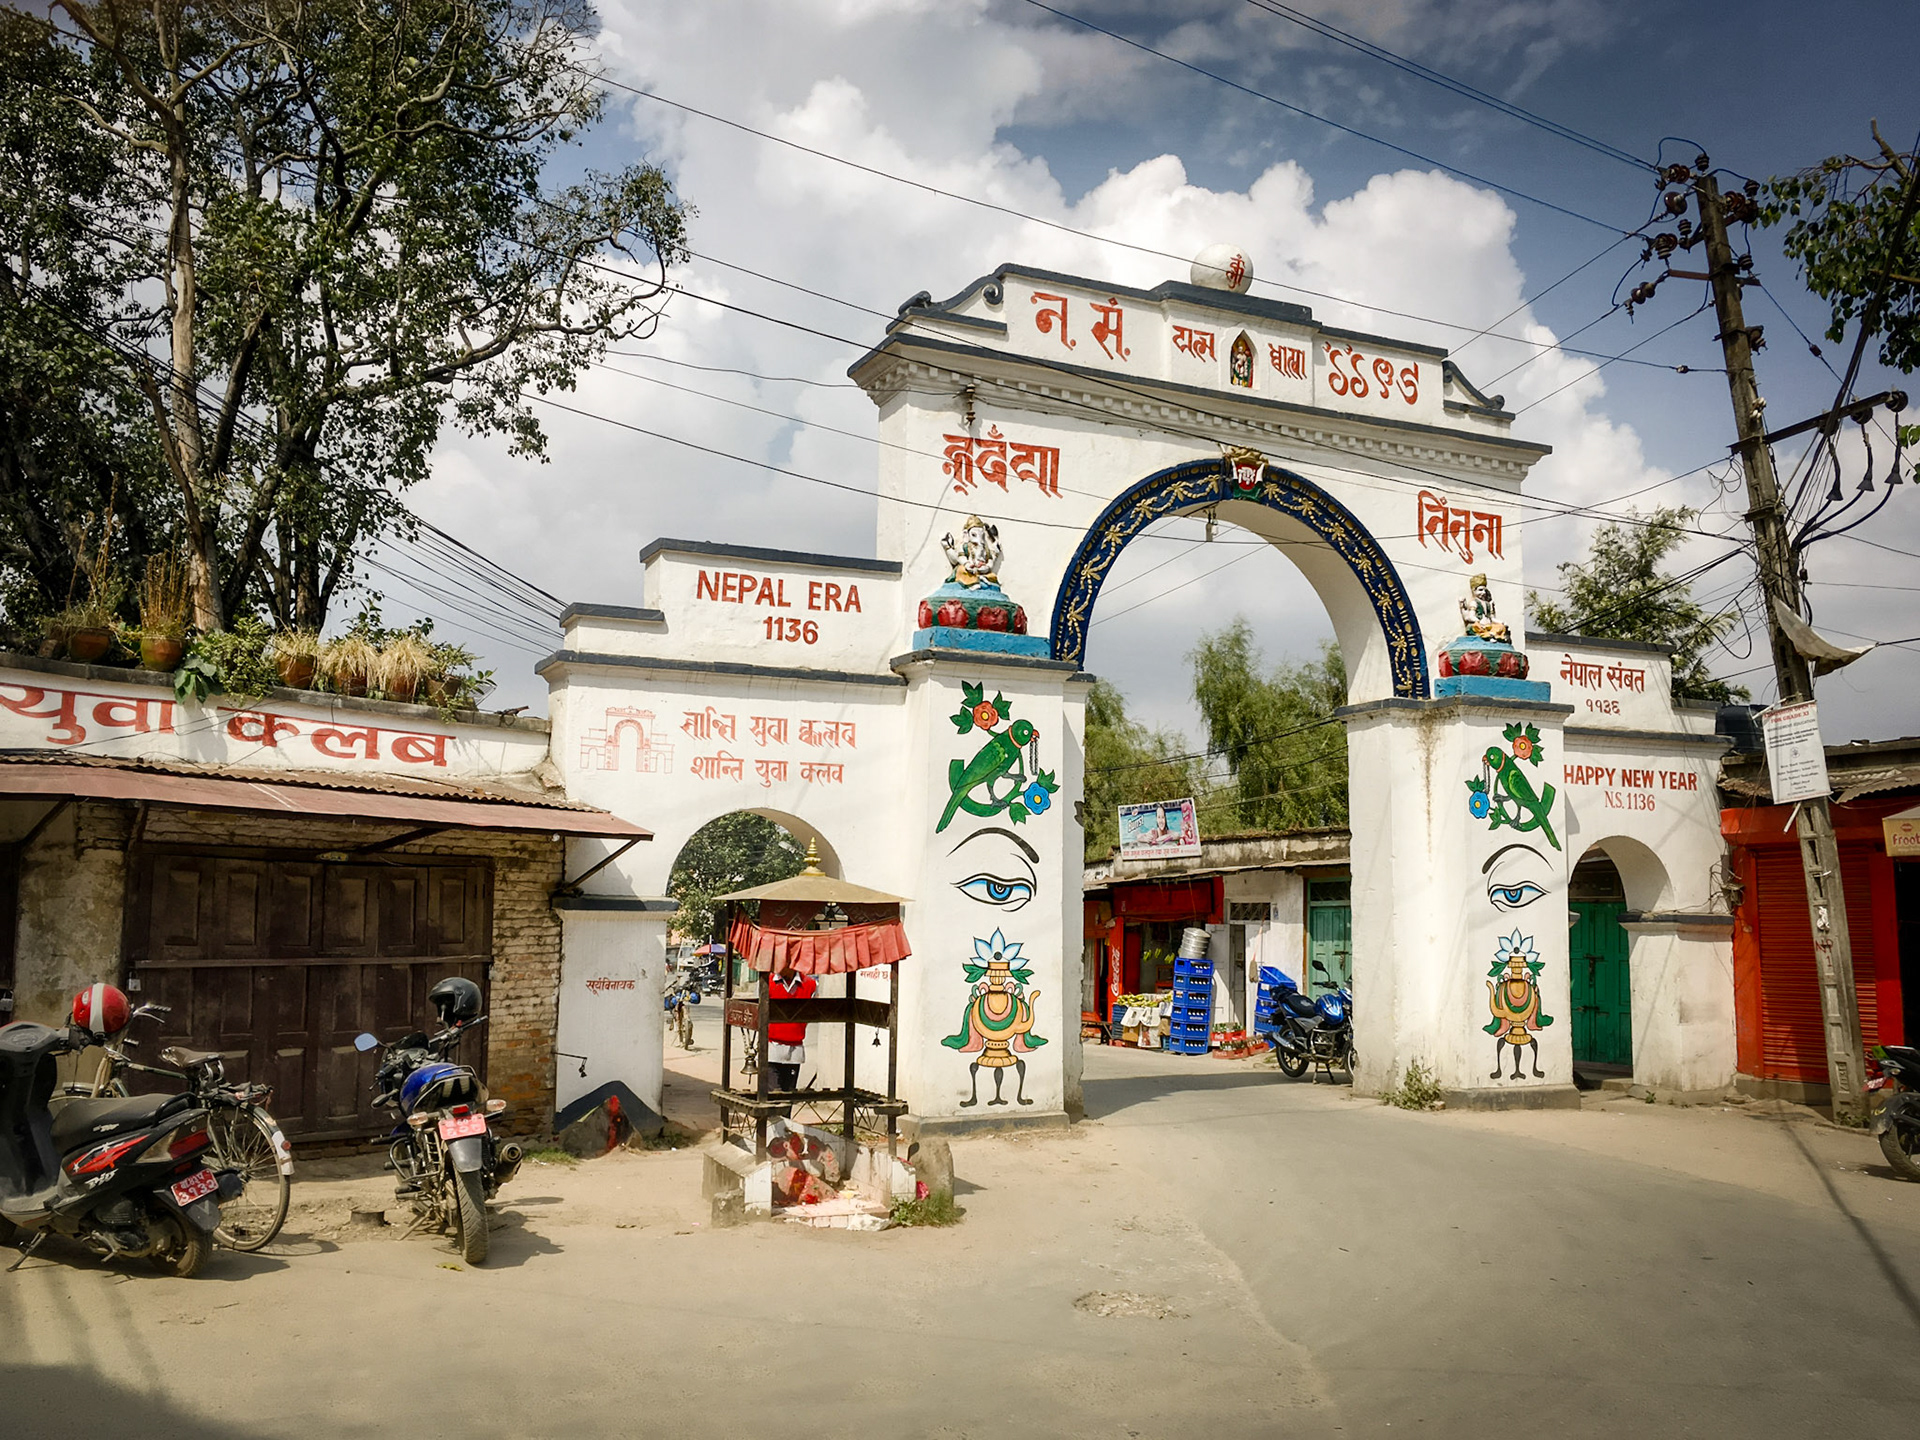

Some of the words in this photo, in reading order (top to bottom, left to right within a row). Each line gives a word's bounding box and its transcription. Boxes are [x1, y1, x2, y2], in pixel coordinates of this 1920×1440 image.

[696, 569, 791, 608] NEPAL
[808, 580, 862, 613] ERA
[763, 615, 819, 645] 1136
[1560, 653, 1604, 691] नेपाल
[0, 682, 178, 745] युवा
[1586, 698, 1621, 716] ११३६
[691, 750, 744, 783] शान्ति
[754, 759, 788, 788] युवा
[1563, 764, 1616, 787] HAPPY
[1621, 769, 1654, 789] NEW
[1658, 771, 1698, 791] YEAR
